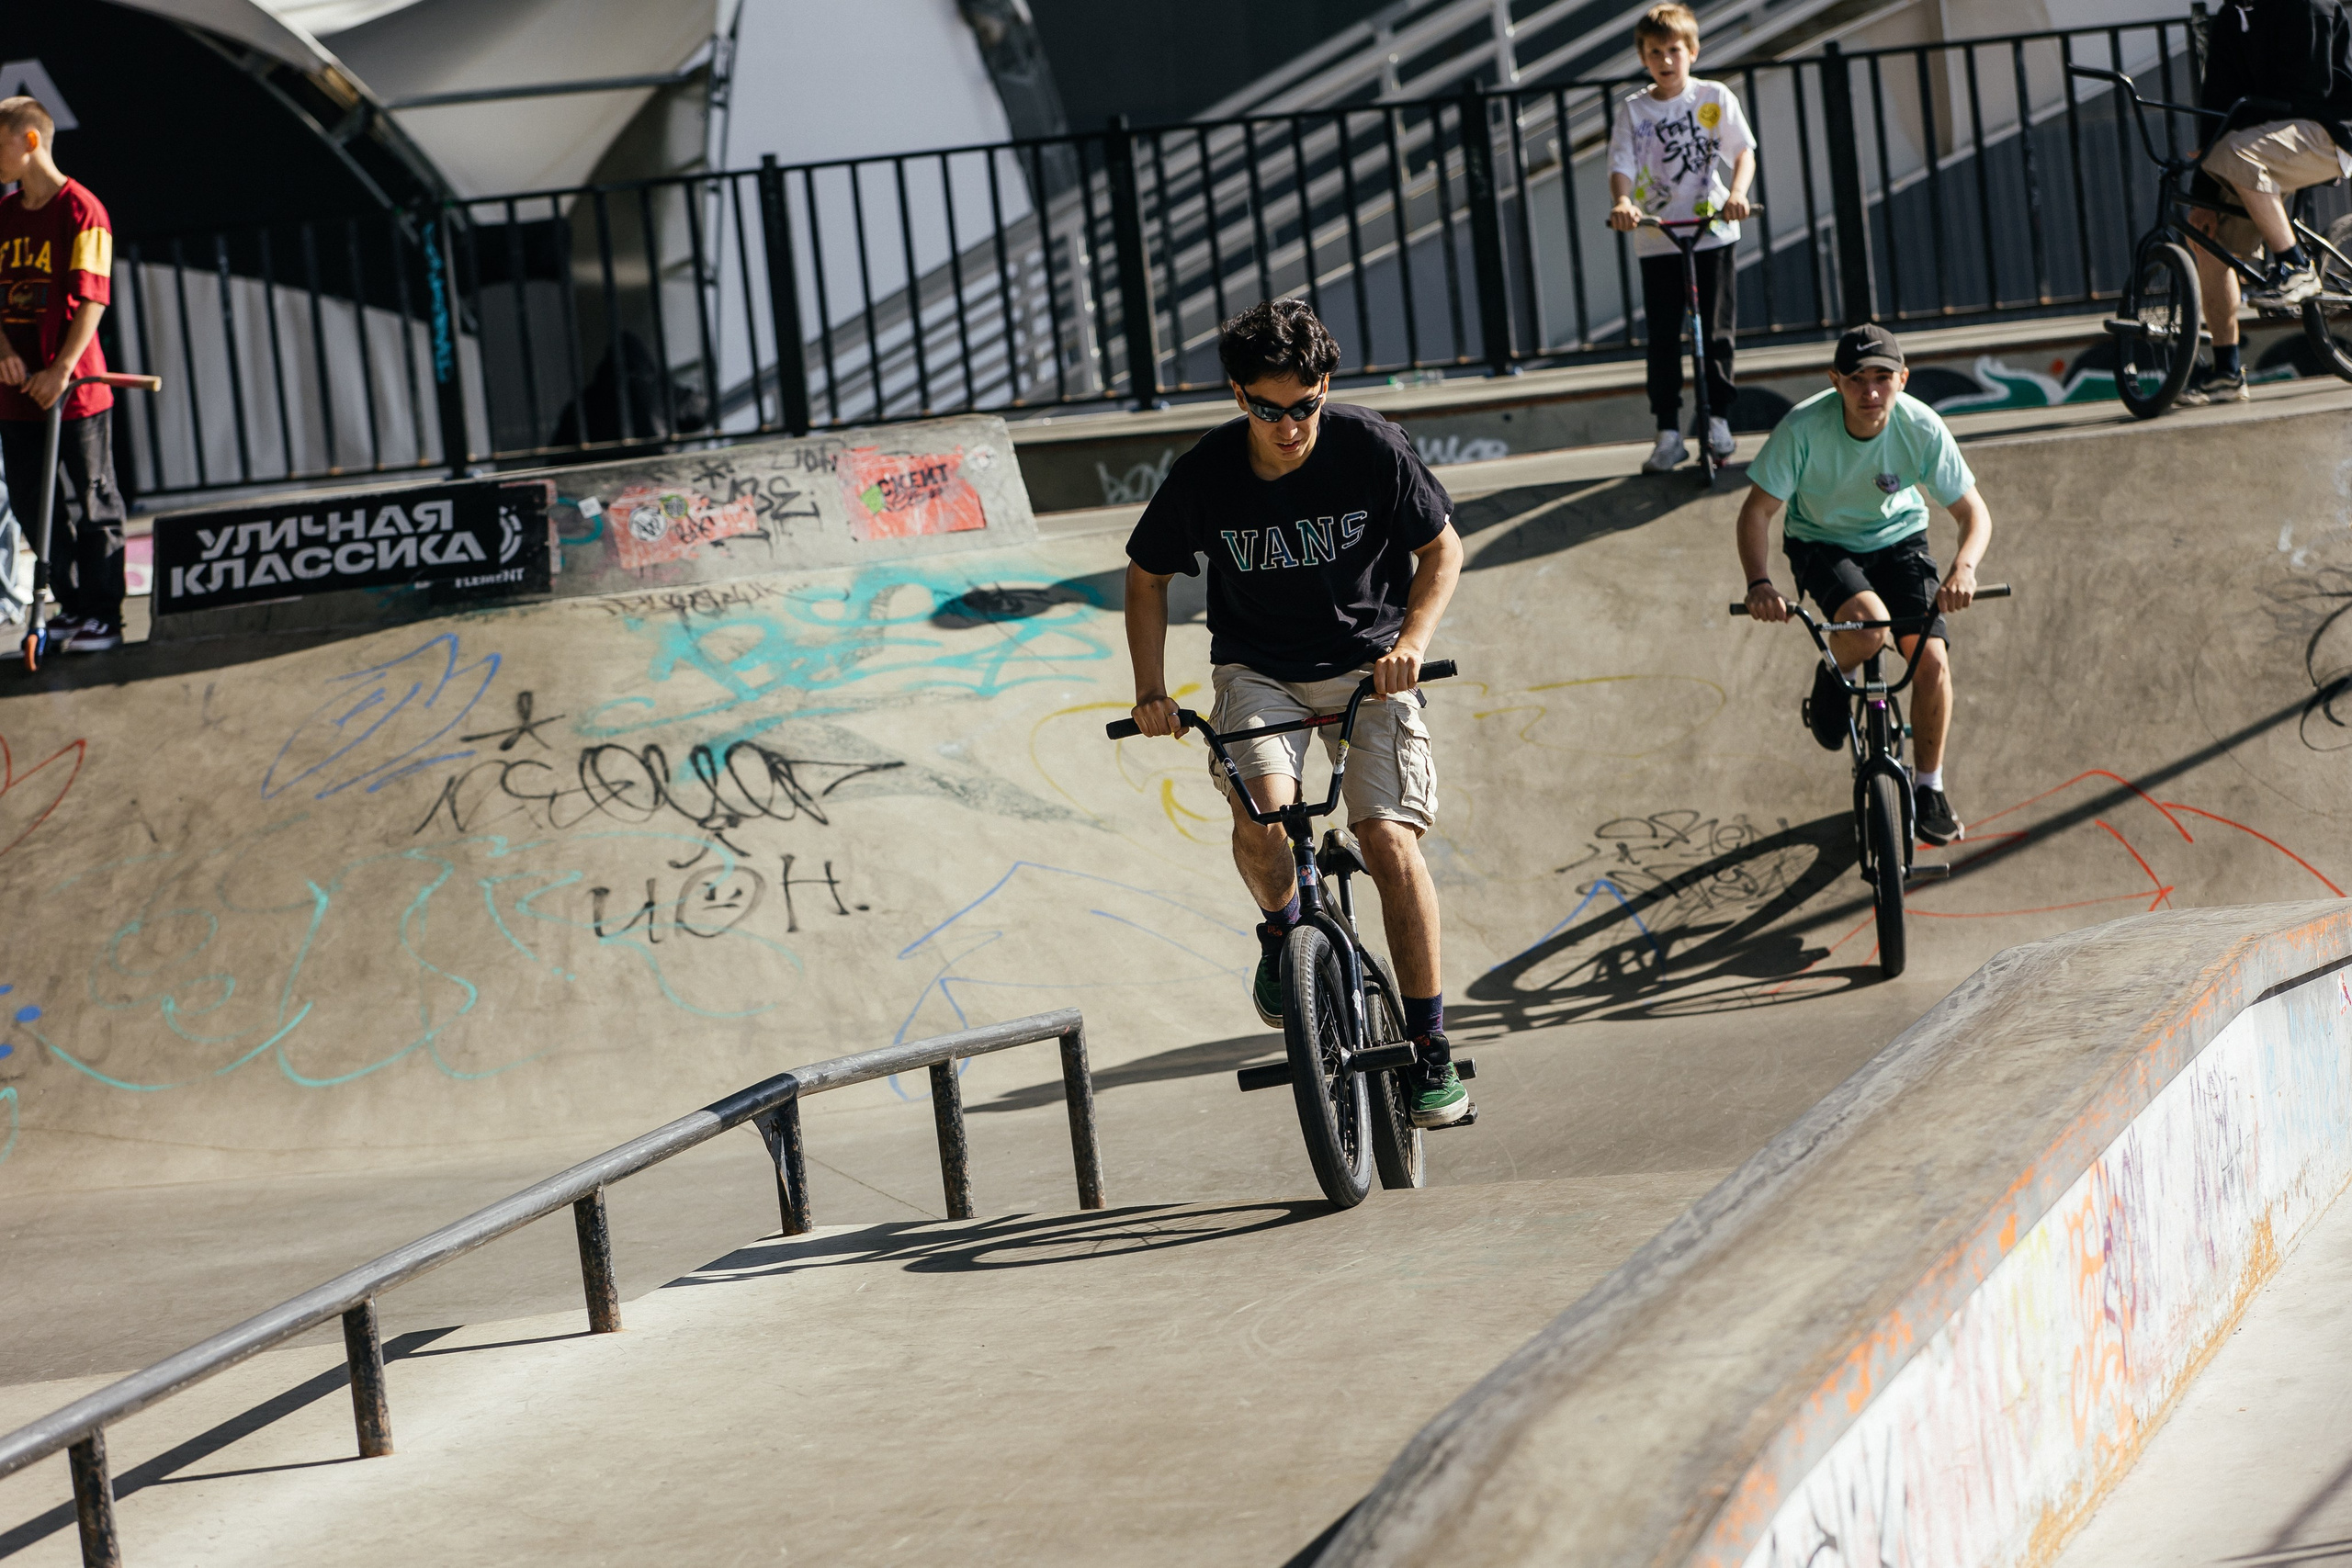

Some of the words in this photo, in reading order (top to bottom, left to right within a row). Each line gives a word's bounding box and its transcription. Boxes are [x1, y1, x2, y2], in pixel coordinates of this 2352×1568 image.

[196, 499, 454, 560] УЛИЧНАЯ
[1220, 510, 1368, 572] VANS
[170, 531, 488, 599] КЛАССИКА
